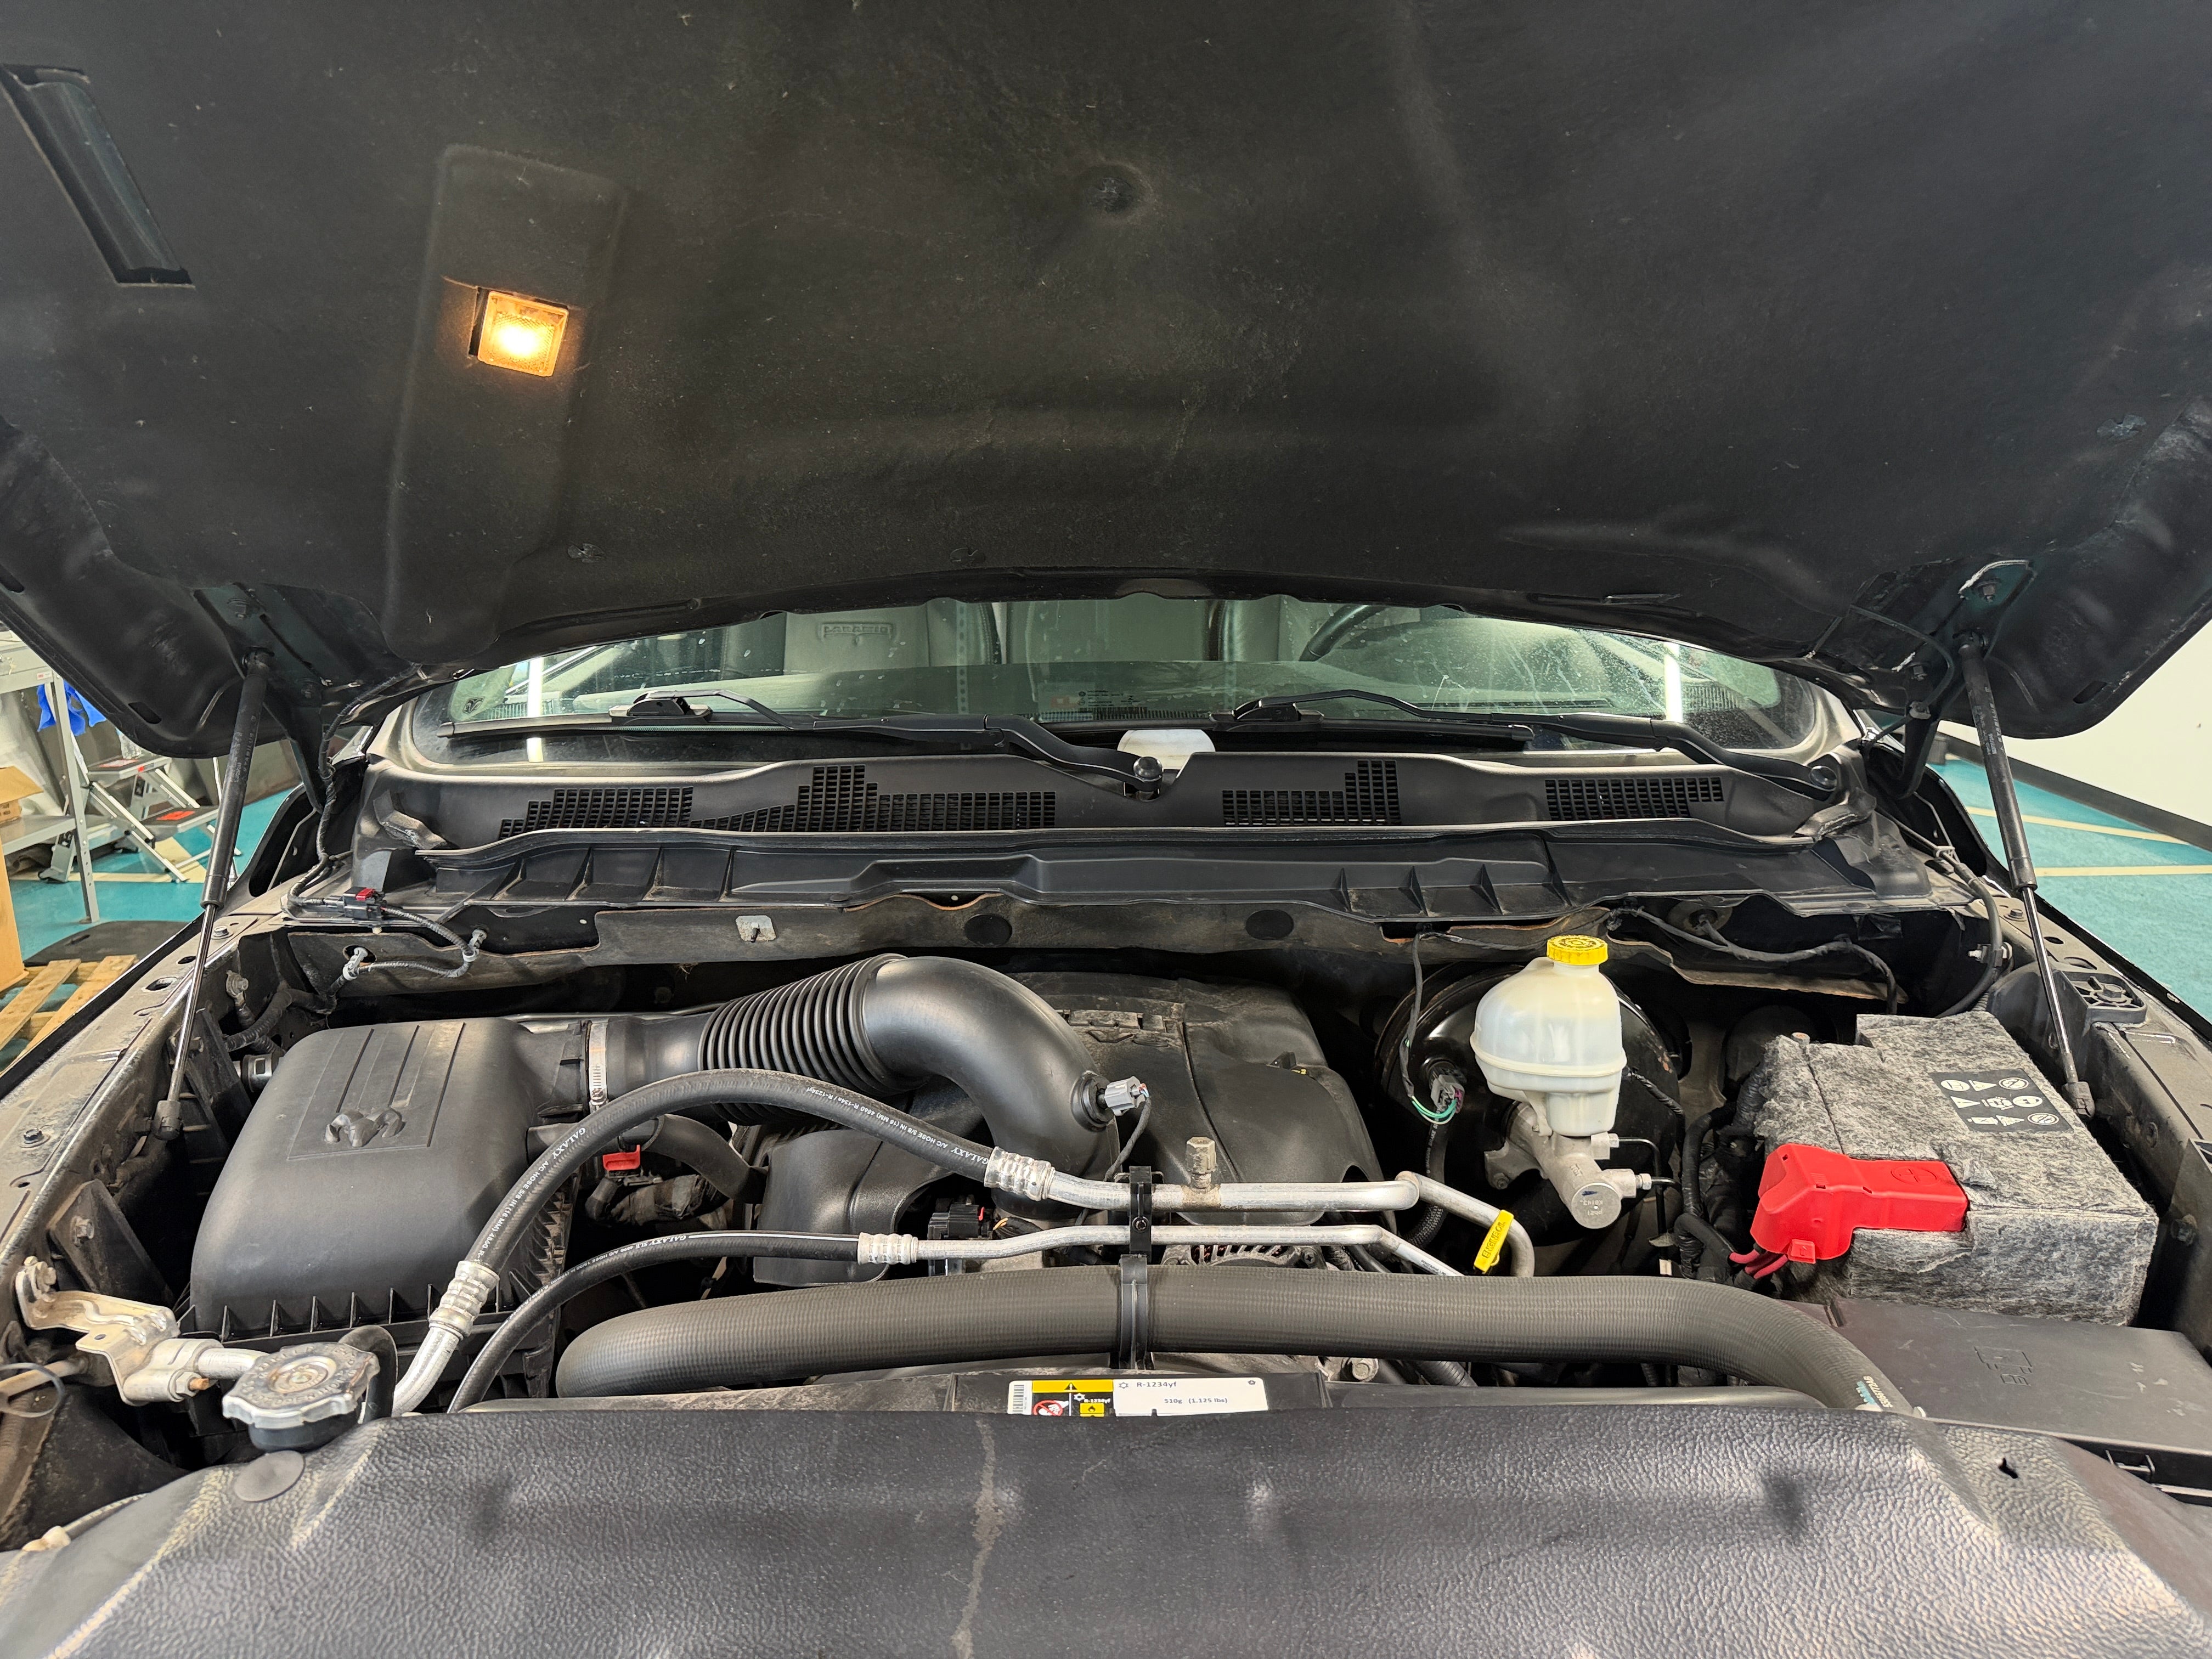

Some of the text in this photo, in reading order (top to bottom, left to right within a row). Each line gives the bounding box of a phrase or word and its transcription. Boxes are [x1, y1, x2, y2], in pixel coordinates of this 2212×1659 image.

[550, 1126, 587, 1160] GALAXY
[917, 1132, 936, 1144] HOSE
[951, 1146, 989, 1165] GALAXY
[522, 1171, 540, 1190] HOSE
[509, 1198, 517, 1208] IN
[648, 1235, 687, 1246] GALAXY
[1481, 1220, 1506, 1259] ENGINE OIL
